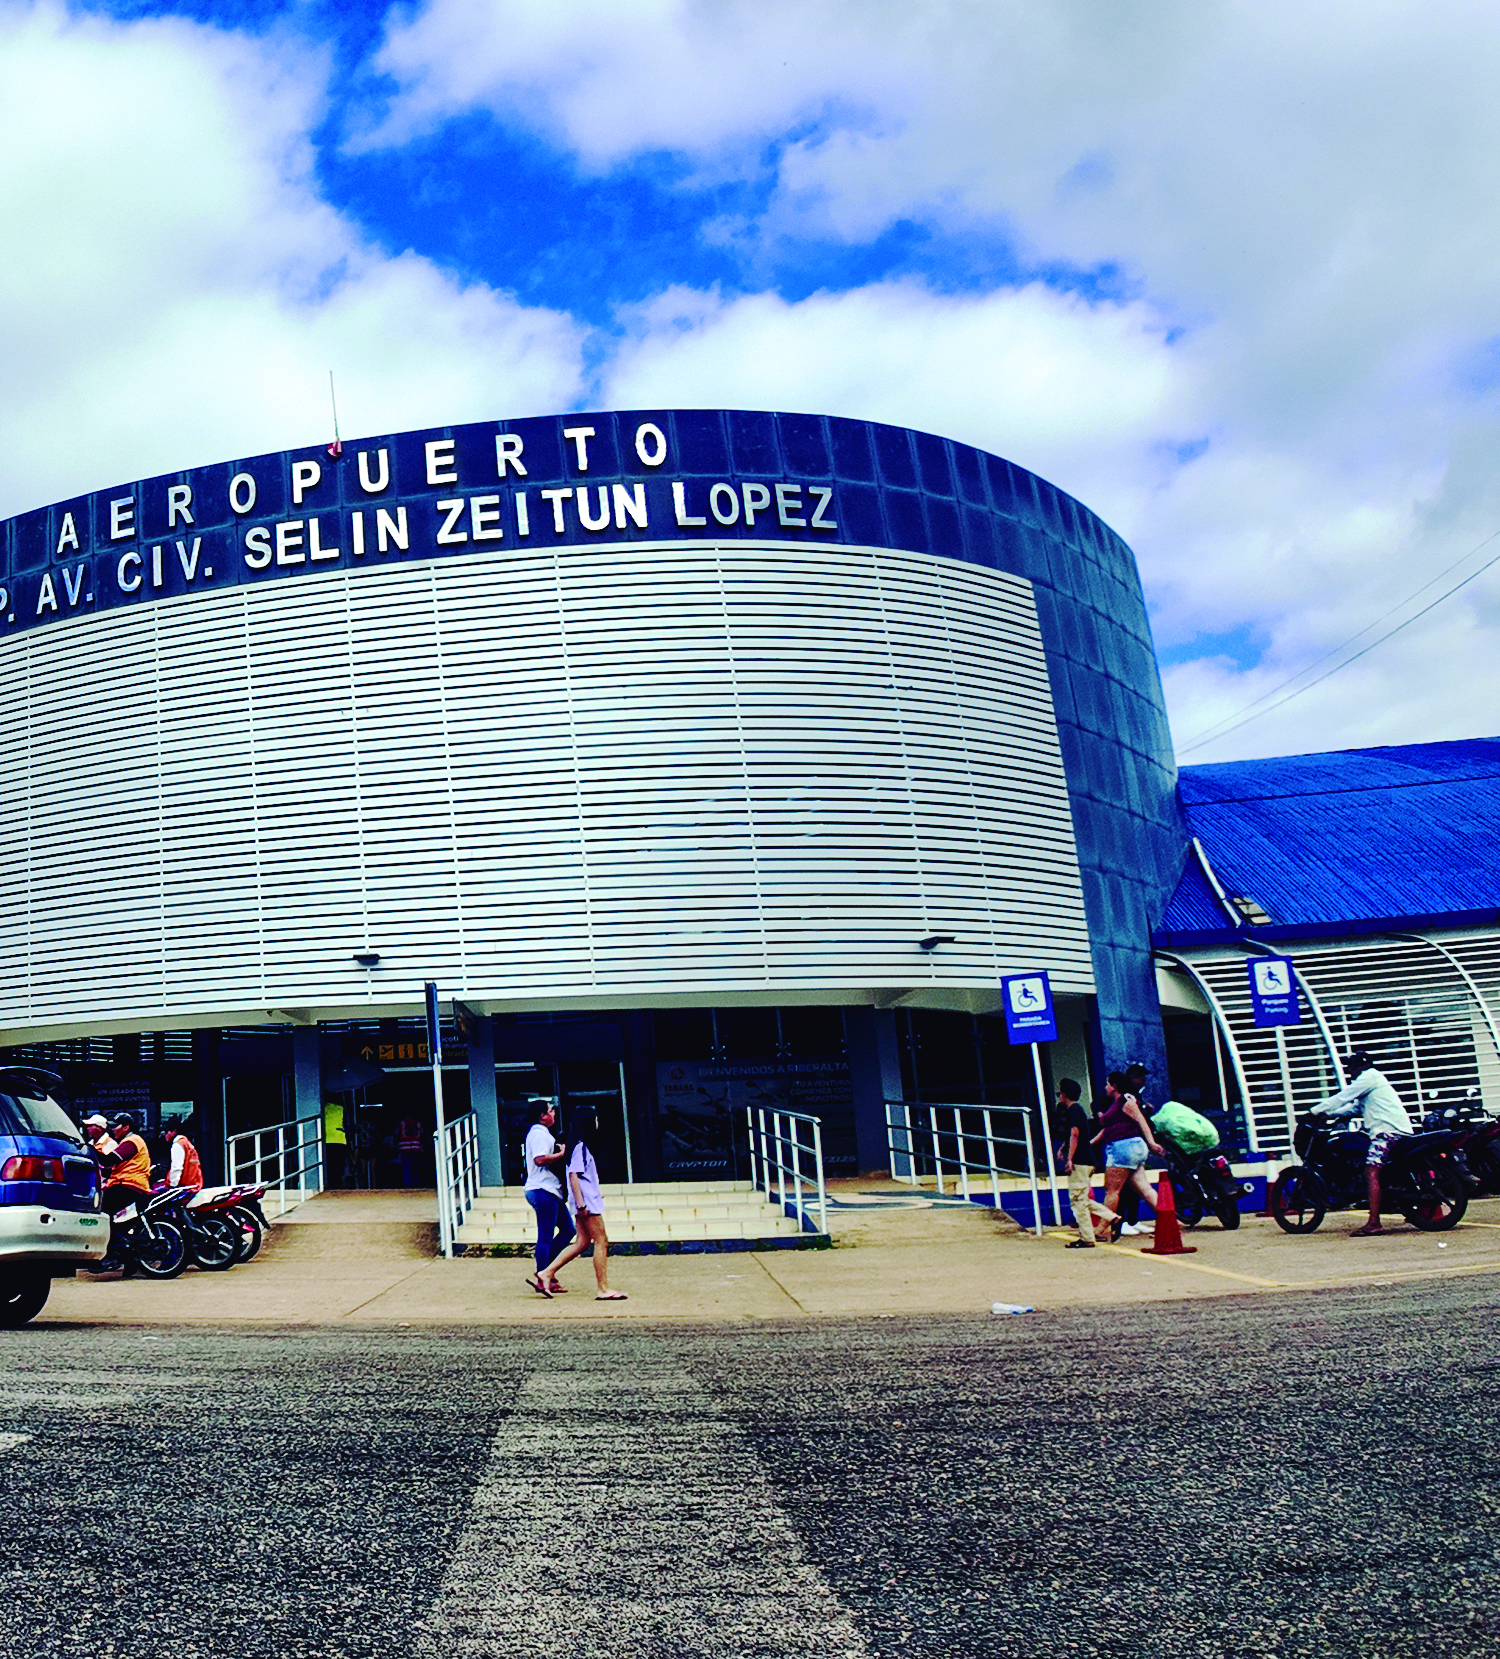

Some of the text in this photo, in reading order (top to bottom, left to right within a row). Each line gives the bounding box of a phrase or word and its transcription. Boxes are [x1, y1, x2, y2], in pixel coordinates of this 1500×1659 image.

[56, 422, 667, 554] AEROPUERTO
[35, 563, 94, 615] AV.
[117, 537, 213, 592] CIV.
[244, 506, 409, 569] SELIN
[436, 481, 649, 545] ZEITUN
[671, 481, 838, 529] LOPEZ
[698, 1062, 849, 1077] BIENVENIDOS A RIBERALTA
[669, 1159, 728, 1169] CRYPTON
